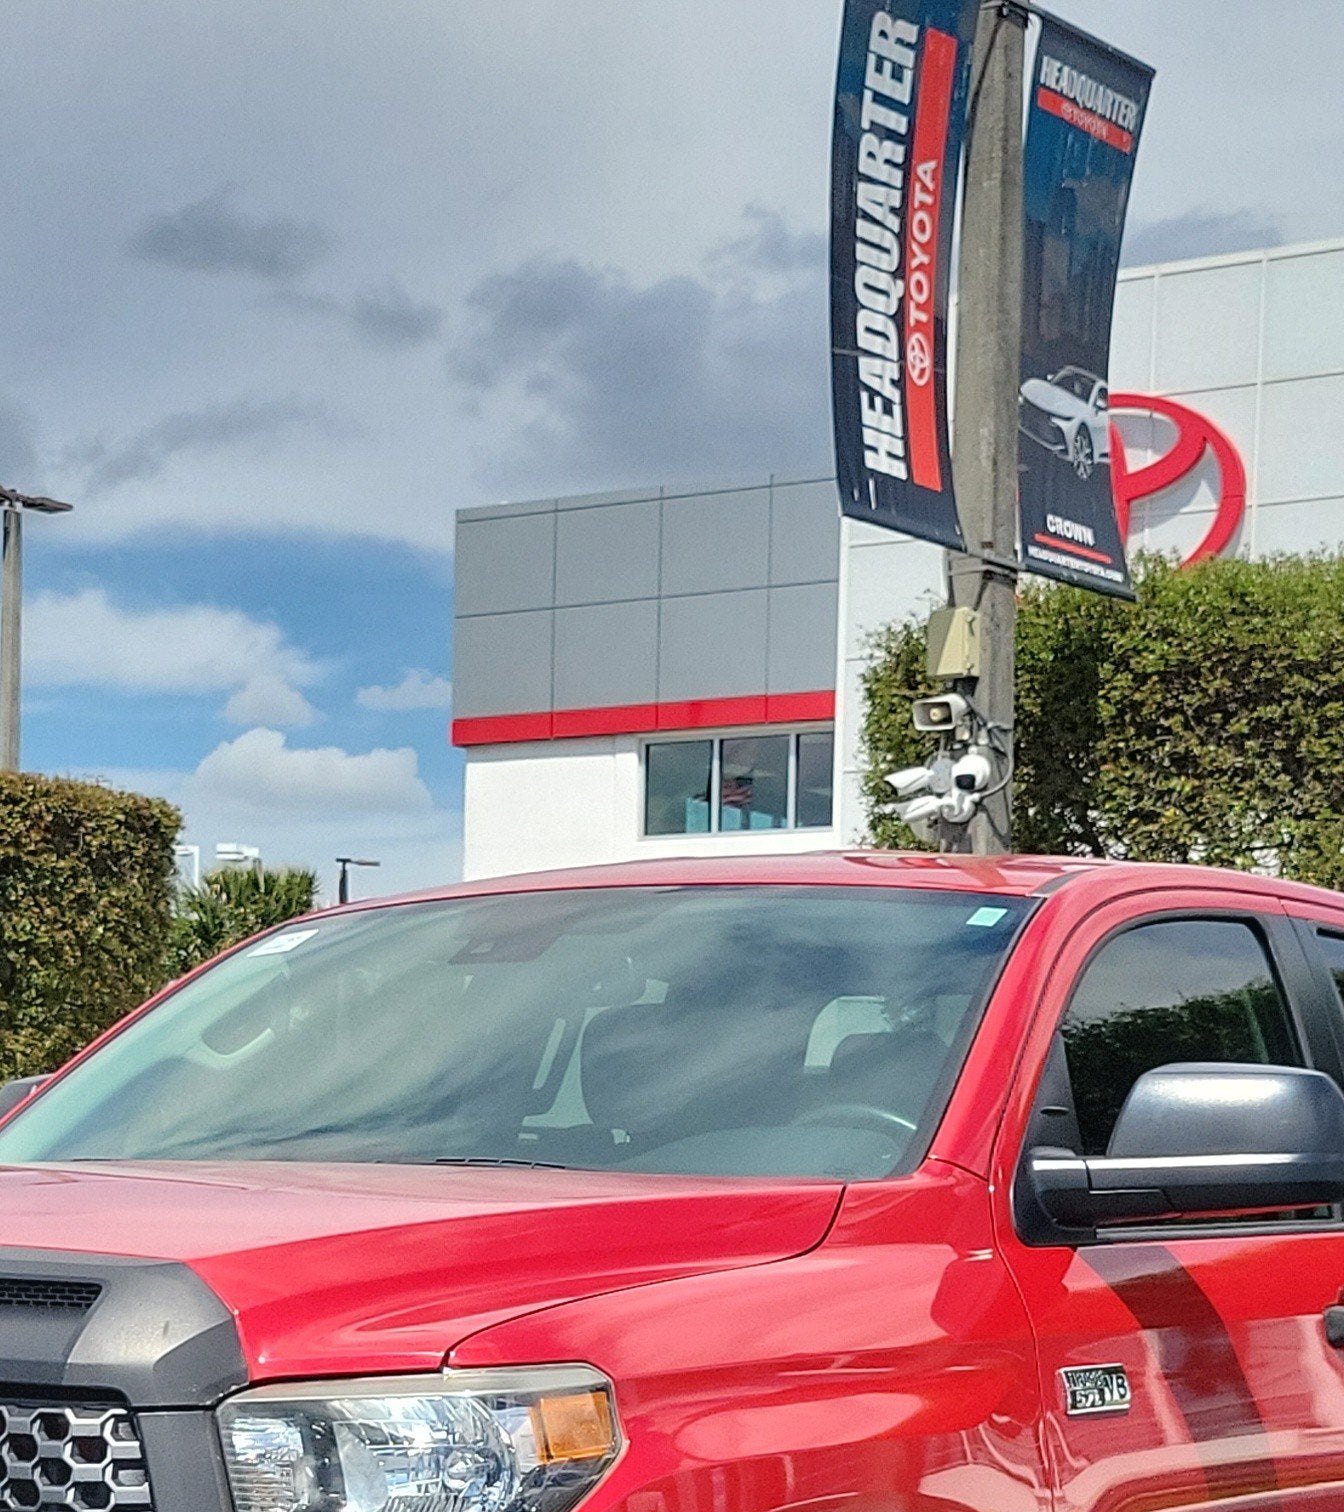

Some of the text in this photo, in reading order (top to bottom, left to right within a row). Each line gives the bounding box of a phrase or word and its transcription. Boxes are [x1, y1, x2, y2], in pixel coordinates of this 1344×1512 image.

[1039, 55, 1137, 131] HEADQUARTER
[854, 11, 919, 480] HEADQUARTER
[908, 160, 938, 327] TOYOTA
[1046, 513, 1096, 547] CROWN
